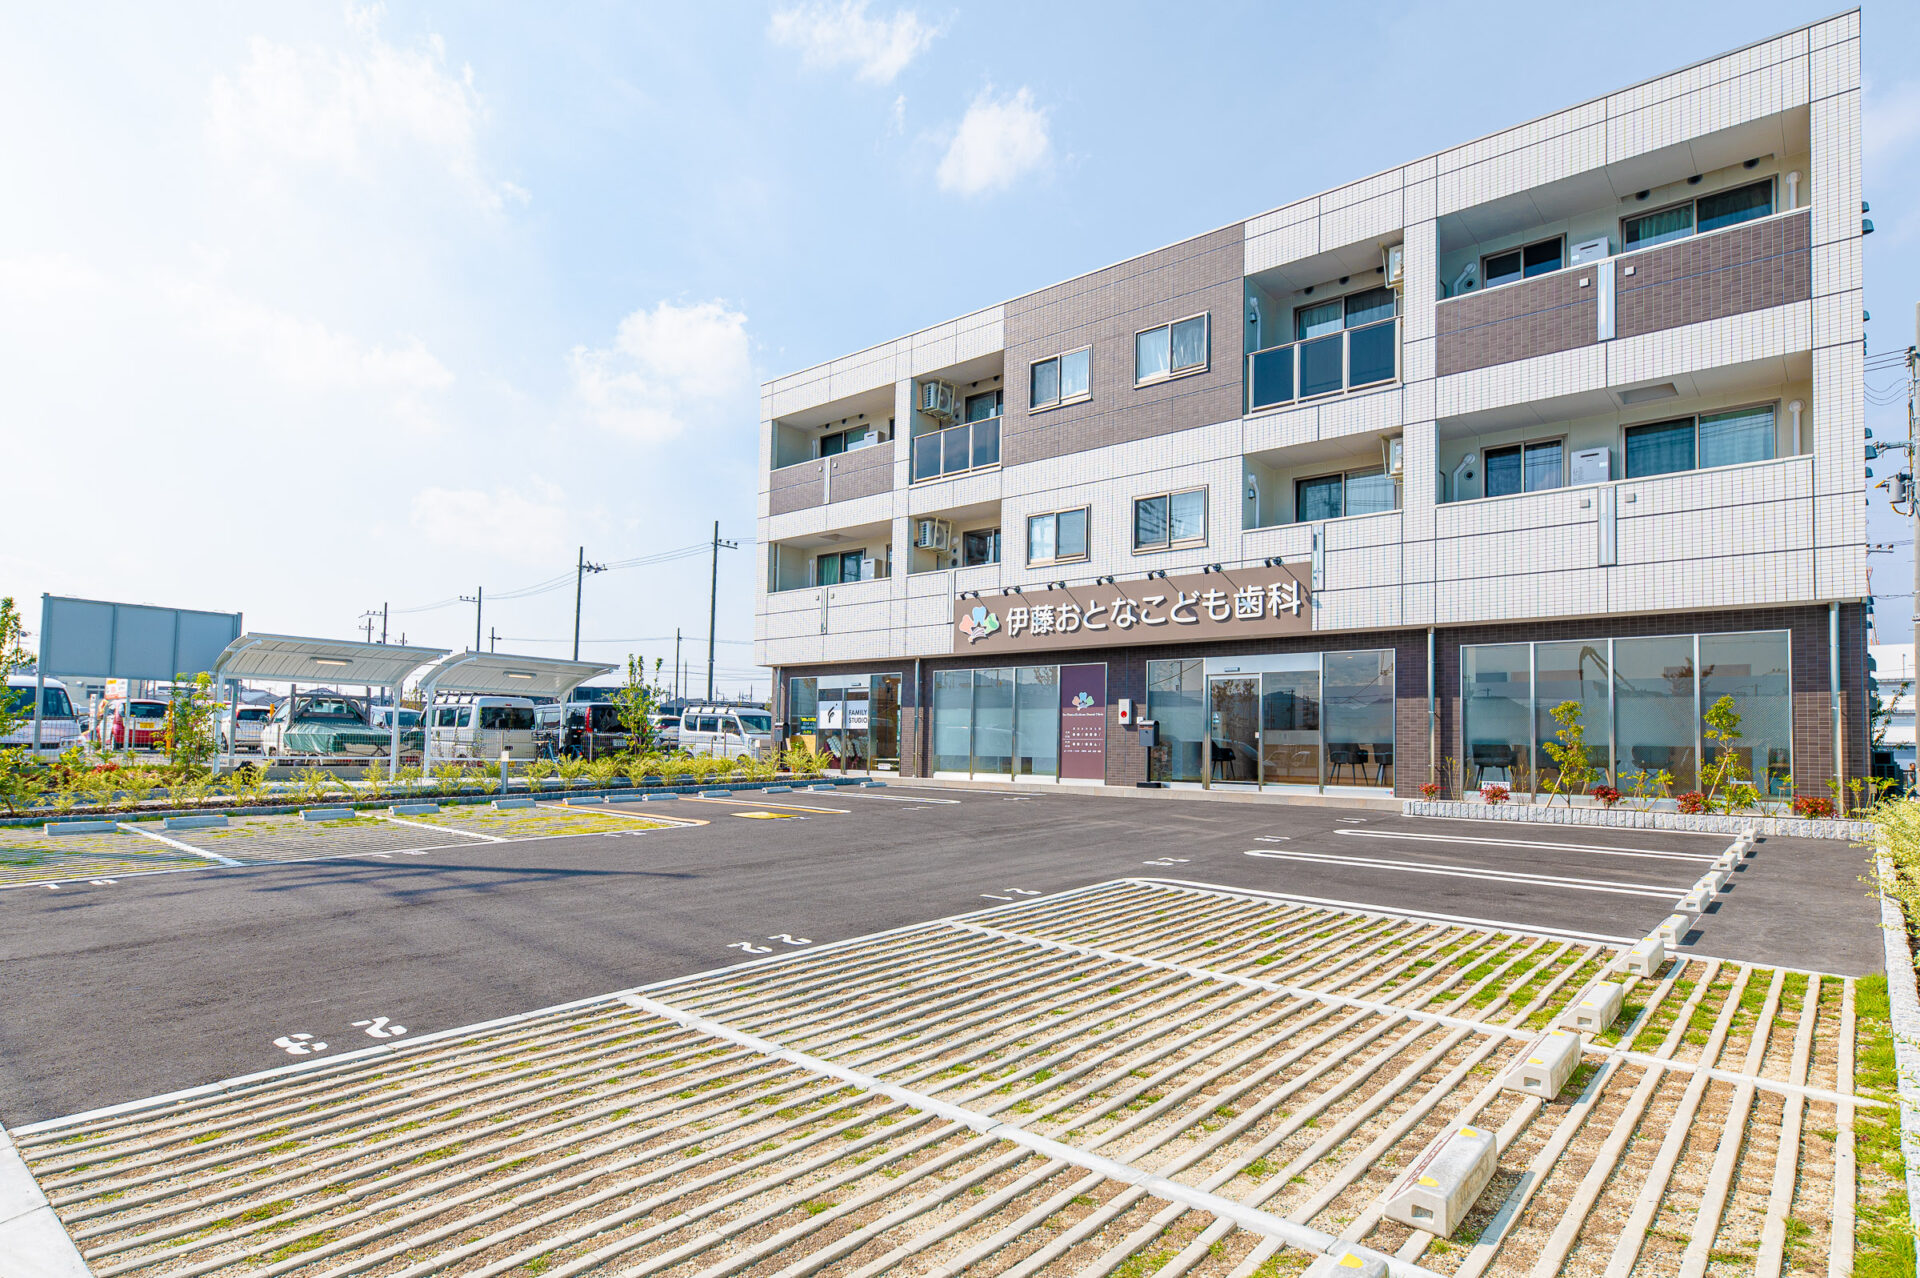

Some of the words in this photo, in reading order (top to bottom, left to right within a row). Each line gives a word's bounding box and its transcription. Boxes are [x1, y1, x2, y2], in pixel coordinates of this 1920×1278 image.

[1005, 580, 1301, 636] 伊藤おとなこども歯科
[726, 933, 813, 954] 22
[272, 1015, 408, 1055] 23
